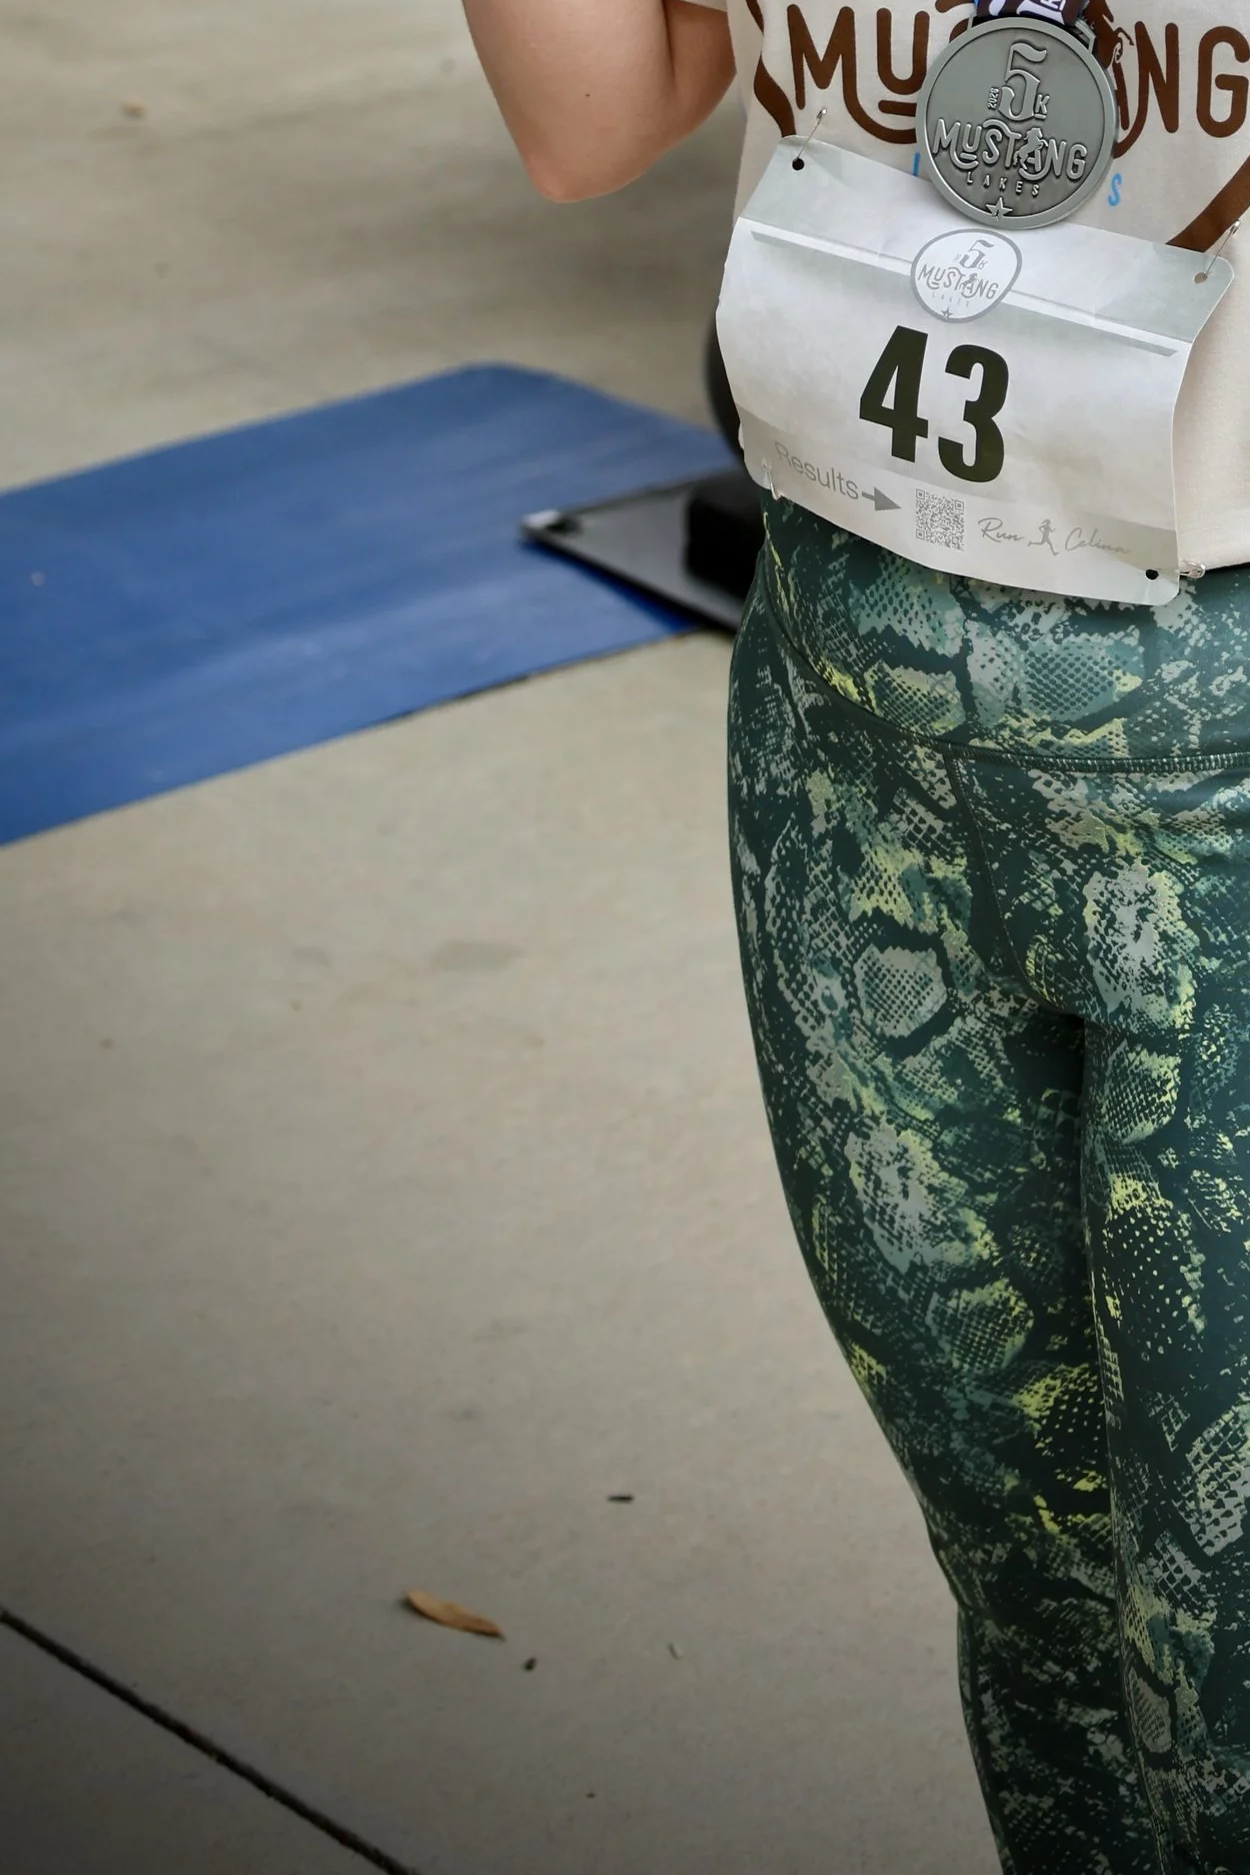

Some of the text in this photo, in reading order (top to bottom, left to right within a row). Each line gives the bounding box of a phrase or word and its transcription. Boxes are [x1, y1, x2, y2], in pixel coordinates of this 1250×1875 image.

[931, 118, 1088, 182] MUSTANG
[966, 171, 1040, 197] LAKES
[917, 264, 1000, 300] MUSTANG
[859, 325, 1010, 484] 43
[774, 441, 860, 501] Results
[977, 516, 1027, 544] Run
